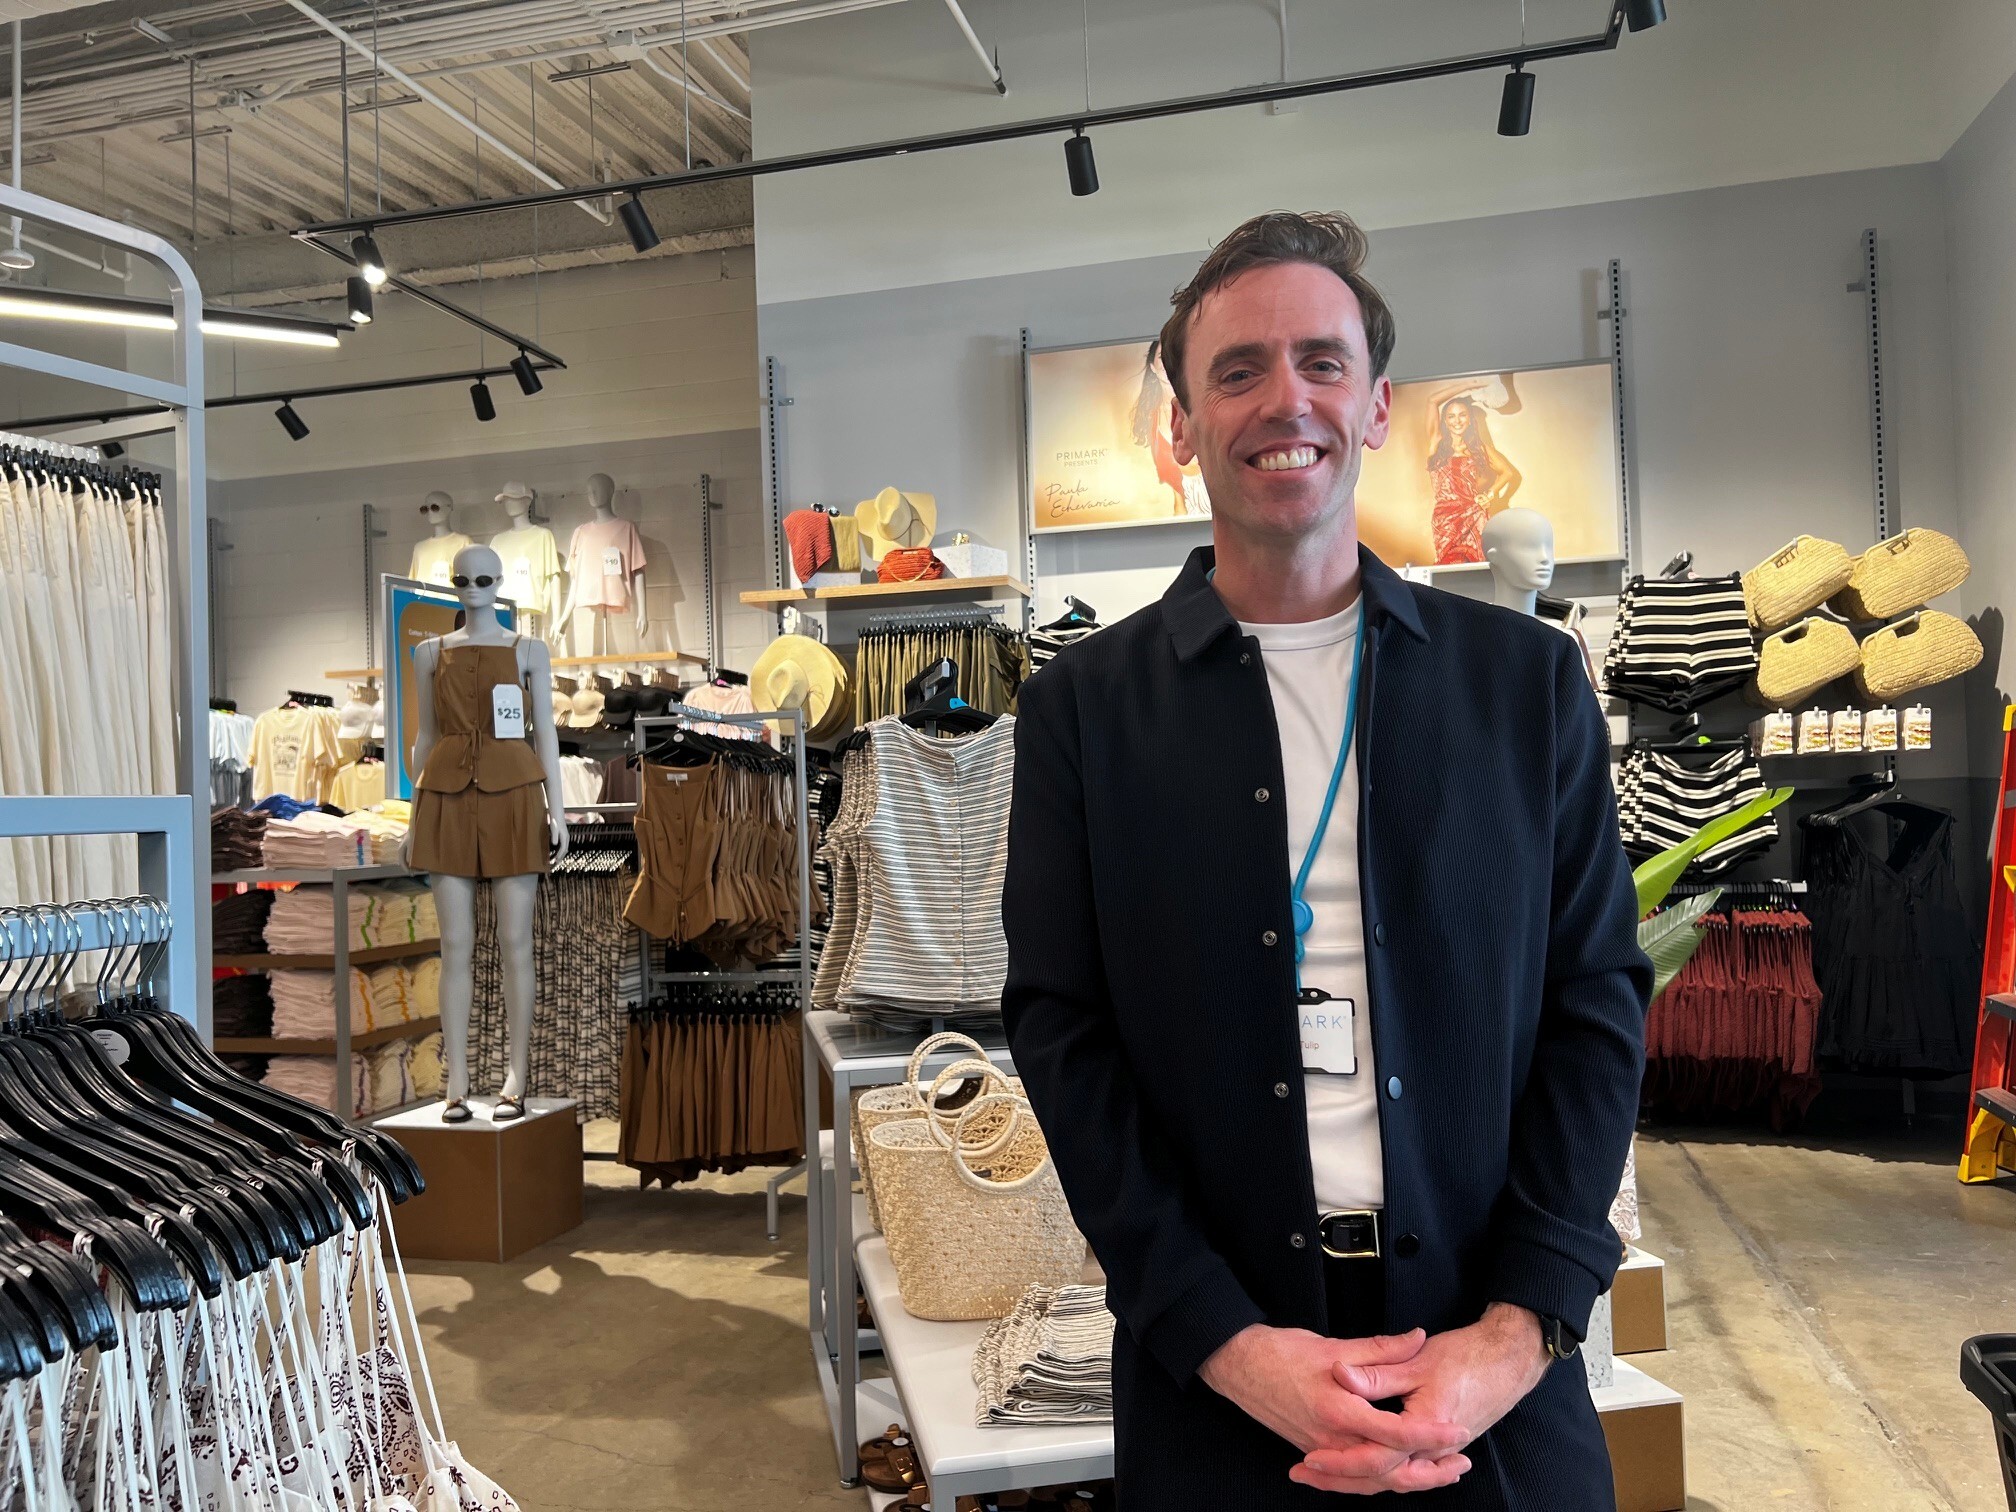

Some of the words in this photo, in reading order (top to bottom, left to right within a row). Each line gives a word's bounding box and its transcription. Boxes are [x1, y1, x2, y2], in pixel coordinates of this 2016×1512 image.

[1056, 449, 1105, 461] PRIMARK
[1063, 459, 1098, 467] PRESENTS
[1045, 479, 1088, 502] Paula
[497, 707, 521, 720] $25
